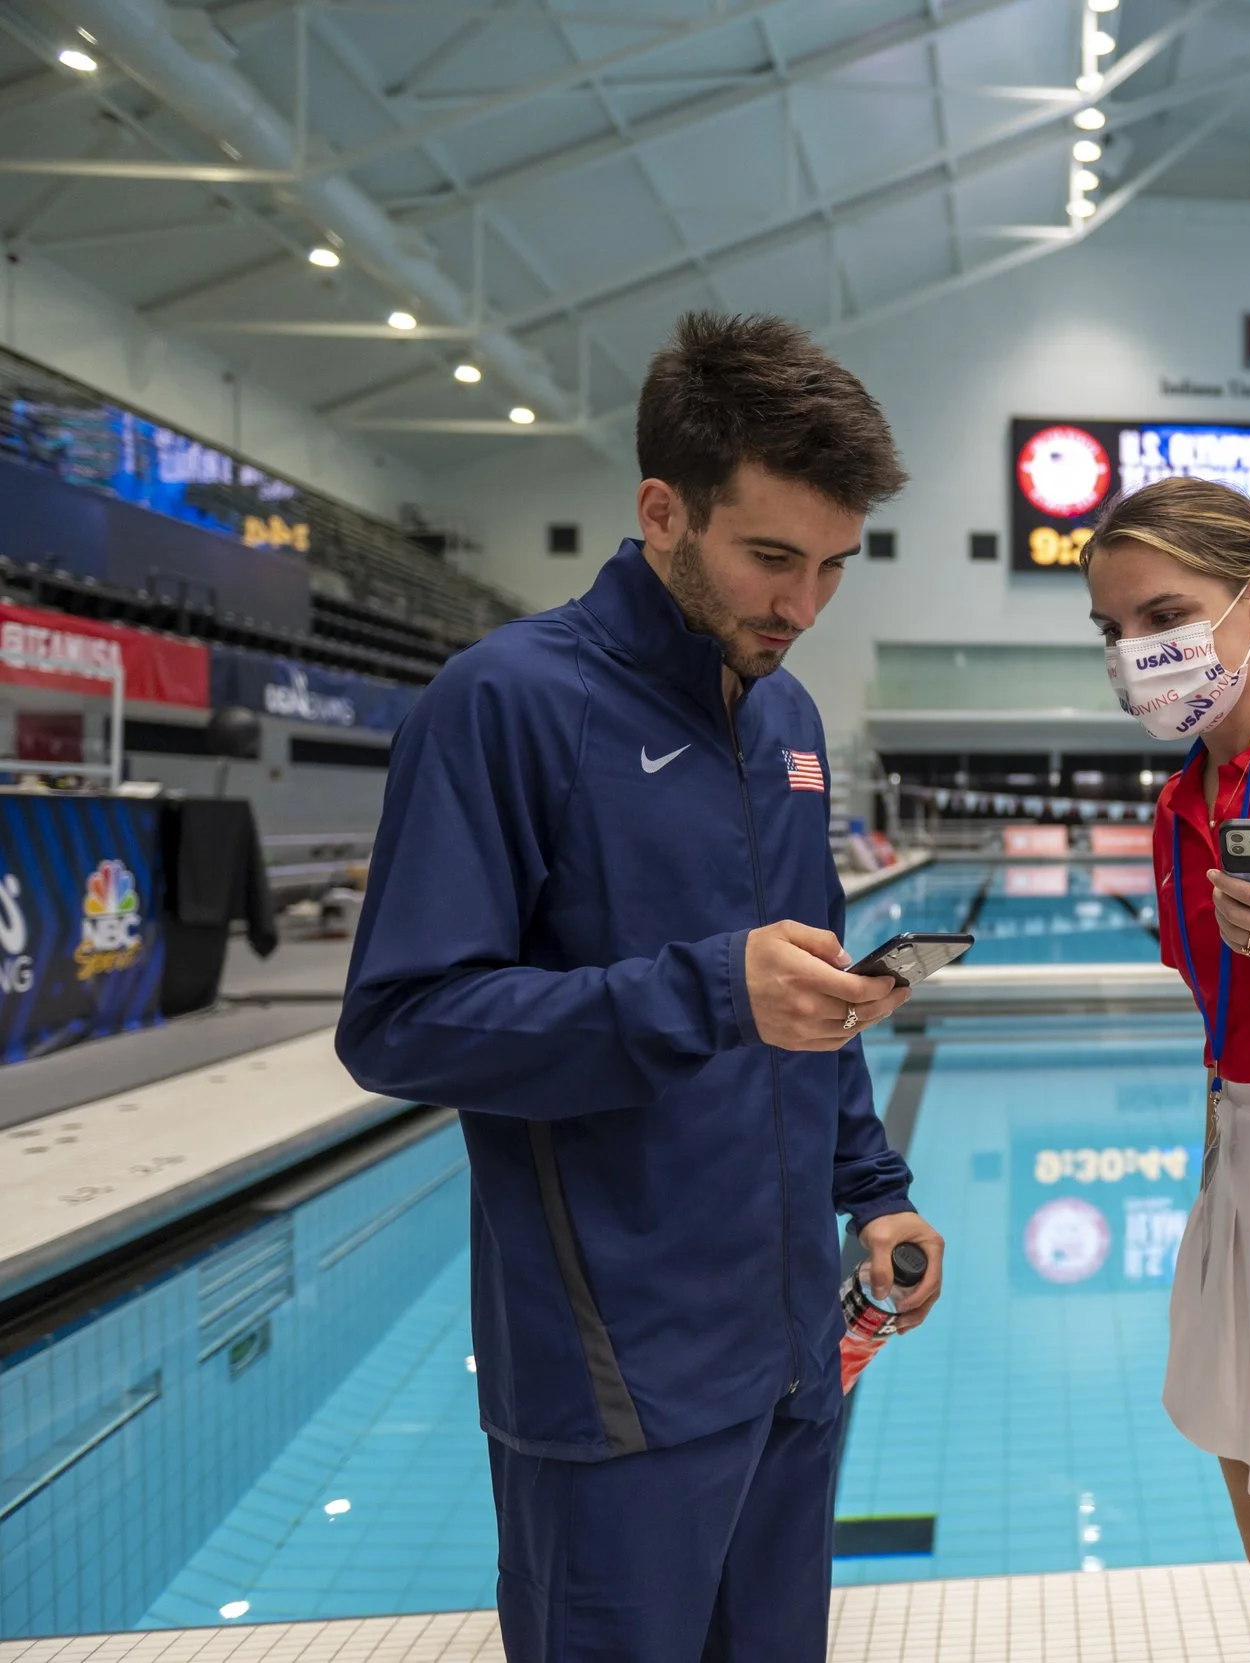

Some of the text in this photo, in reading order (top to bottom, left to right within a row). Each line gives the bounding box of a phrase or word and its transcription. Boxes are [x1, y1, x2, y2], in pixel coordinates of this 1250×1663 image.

[1136, 656, 1171, 670] USA
[1132, 689, 1180, 717] DIVING
[1176, 708, 1206, 733] USA
[81, 914, 142, 951] NBC
